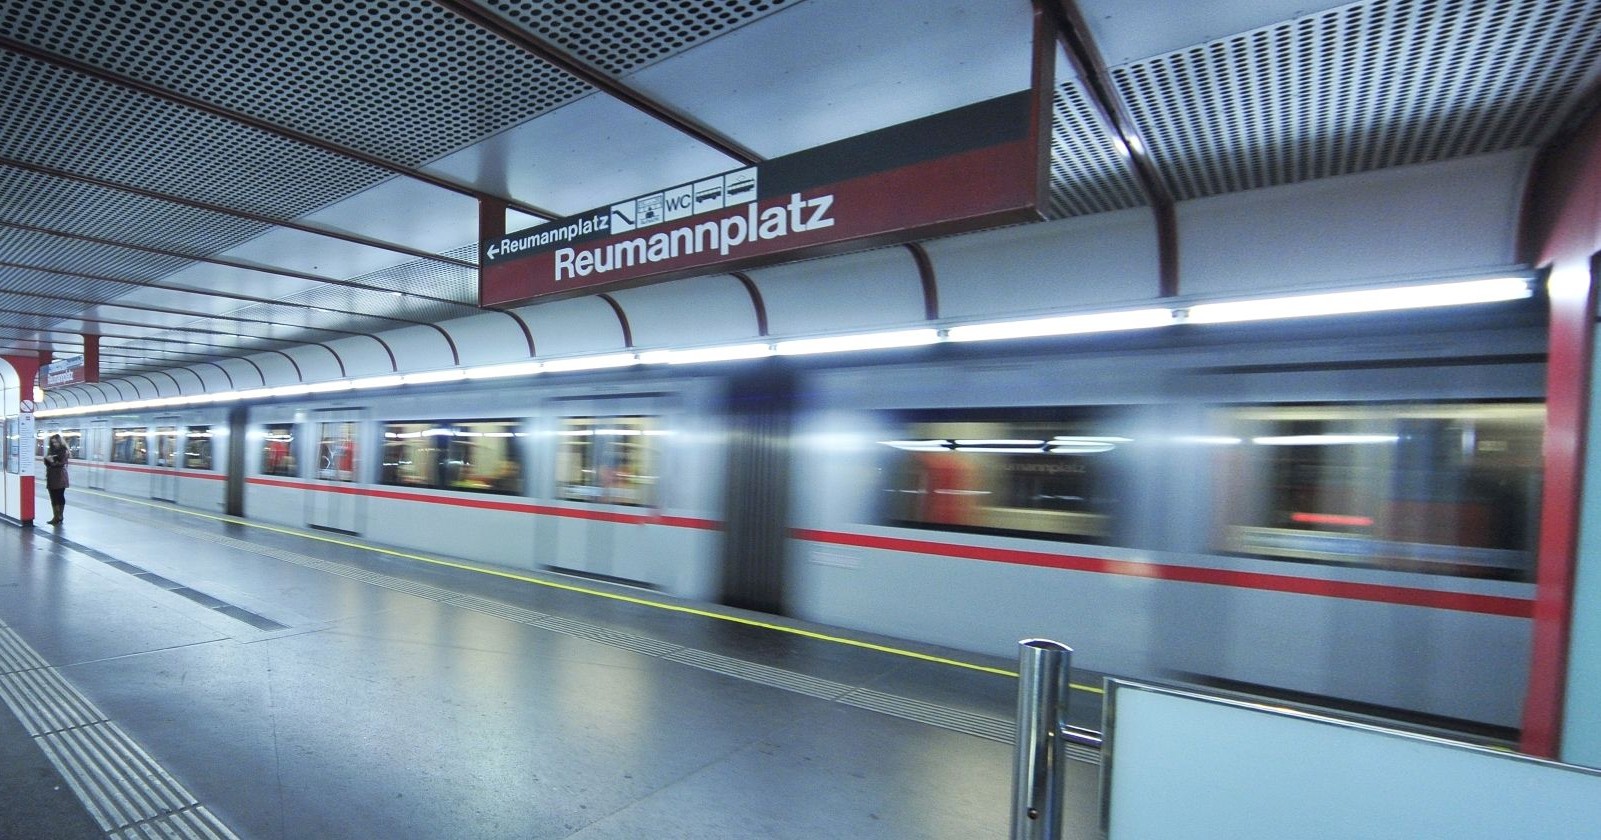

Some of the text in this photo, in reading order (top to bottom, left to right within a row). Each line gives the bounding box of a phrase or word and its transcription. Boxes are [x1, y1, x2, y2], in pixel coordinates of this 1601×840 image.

[500, 194, 691, 256] Reumannplatz WC
[554, 192, 835, 281] Reumannplatz
